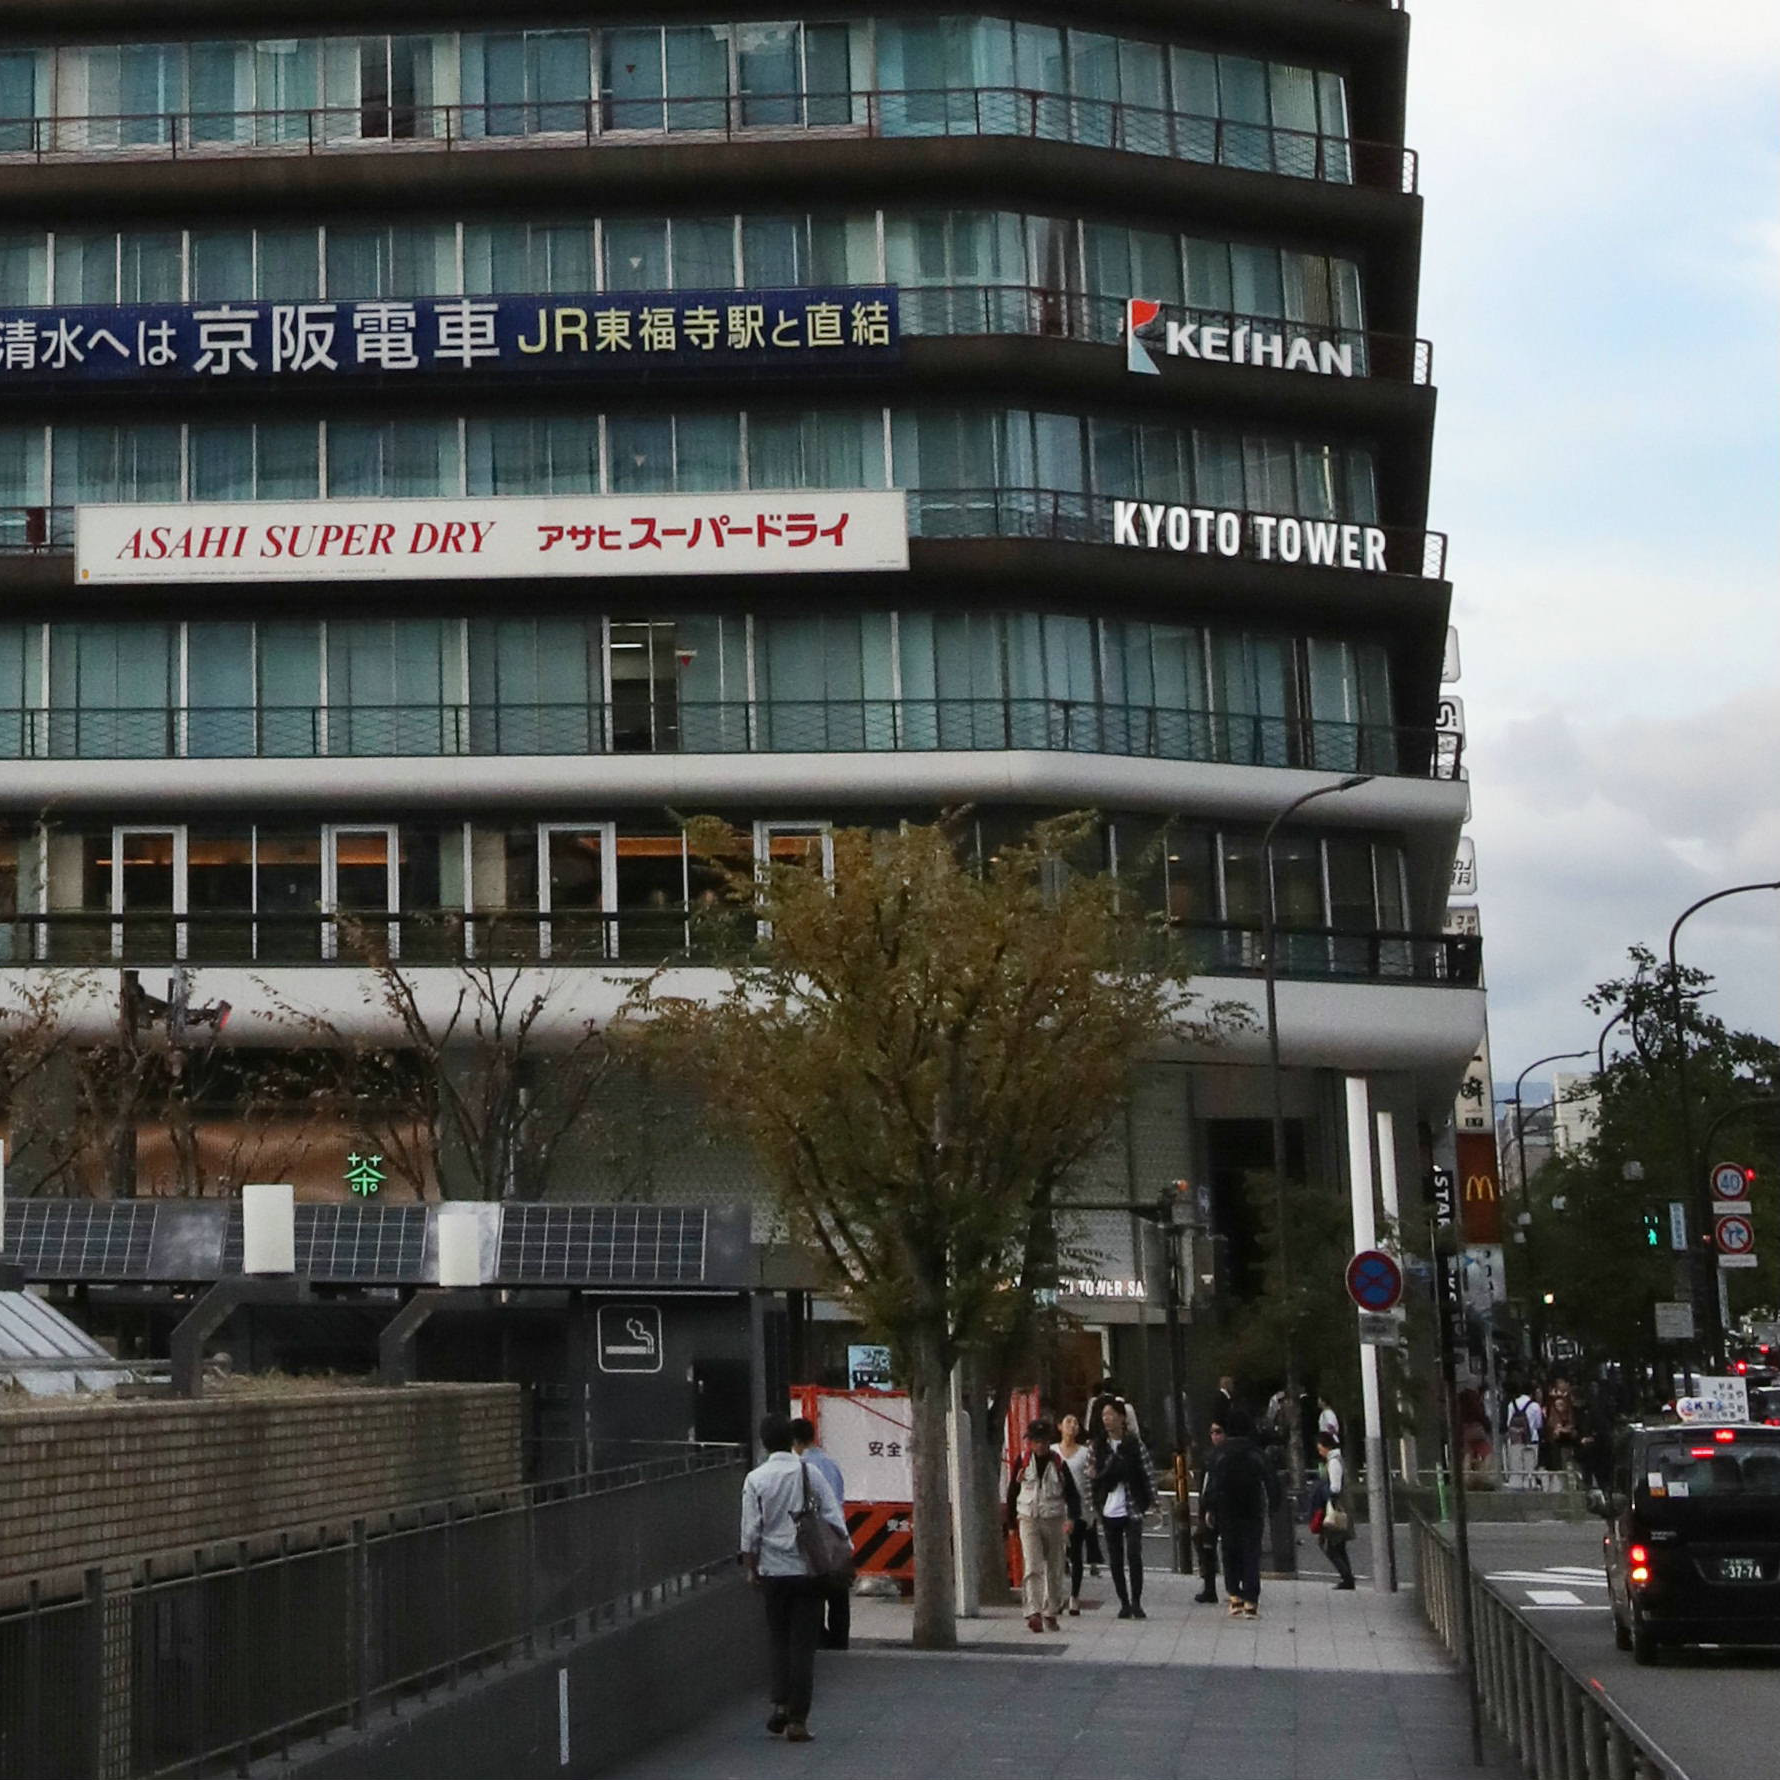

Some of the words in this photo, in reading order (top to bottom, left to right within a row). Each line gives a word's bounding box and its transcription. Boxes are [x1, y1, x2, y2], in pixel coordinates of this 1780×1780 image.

[192, 302, 501, 375] 京阪電車
[517, 300, 890, 353] JR東福寺駅と直結
[1166, 318, 1353, 378] KEIHAN
[116, 525, 250, 561] ASAHI
[259, 523, 398, 558] SUPER
[408, 521, 498, 555] DRY
[1113, 500, 1241, 557] KYOTO
[1253, 515, 1388, 572] TOWER
[1720, 1173, 1741, 1191] 40
